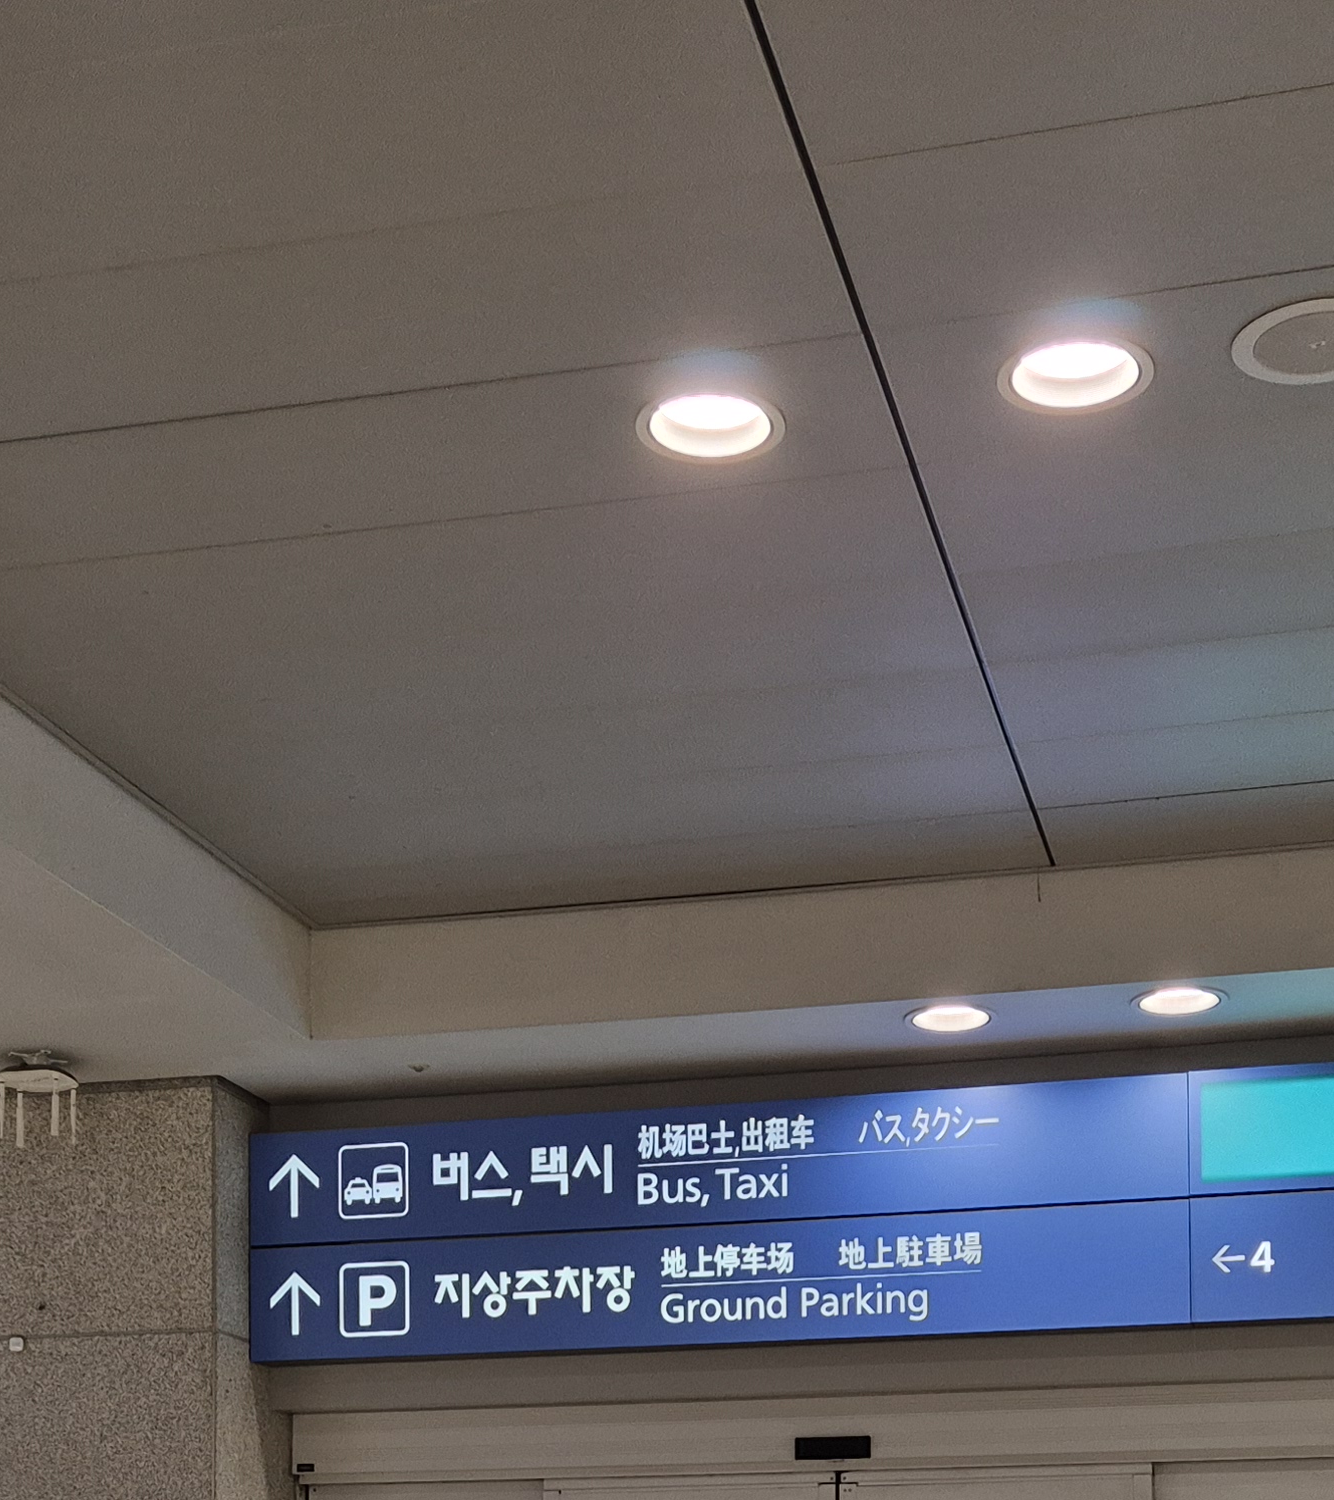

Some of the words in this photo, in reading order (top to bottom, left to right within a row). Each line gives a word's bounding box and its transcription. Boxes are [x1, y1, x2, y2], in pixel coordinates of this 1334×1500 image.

[661, 1243, 793, 1278] 地上停车场
[839, 1232, 983, 1271] 地上駐車場
[1250, 1241, 1274, 1272] 4
[435, 1266, 635, 1318] 지상주차장
[661, 1287, 786, 1323] Ground
[802, 1283, 927, 1321] Parking
